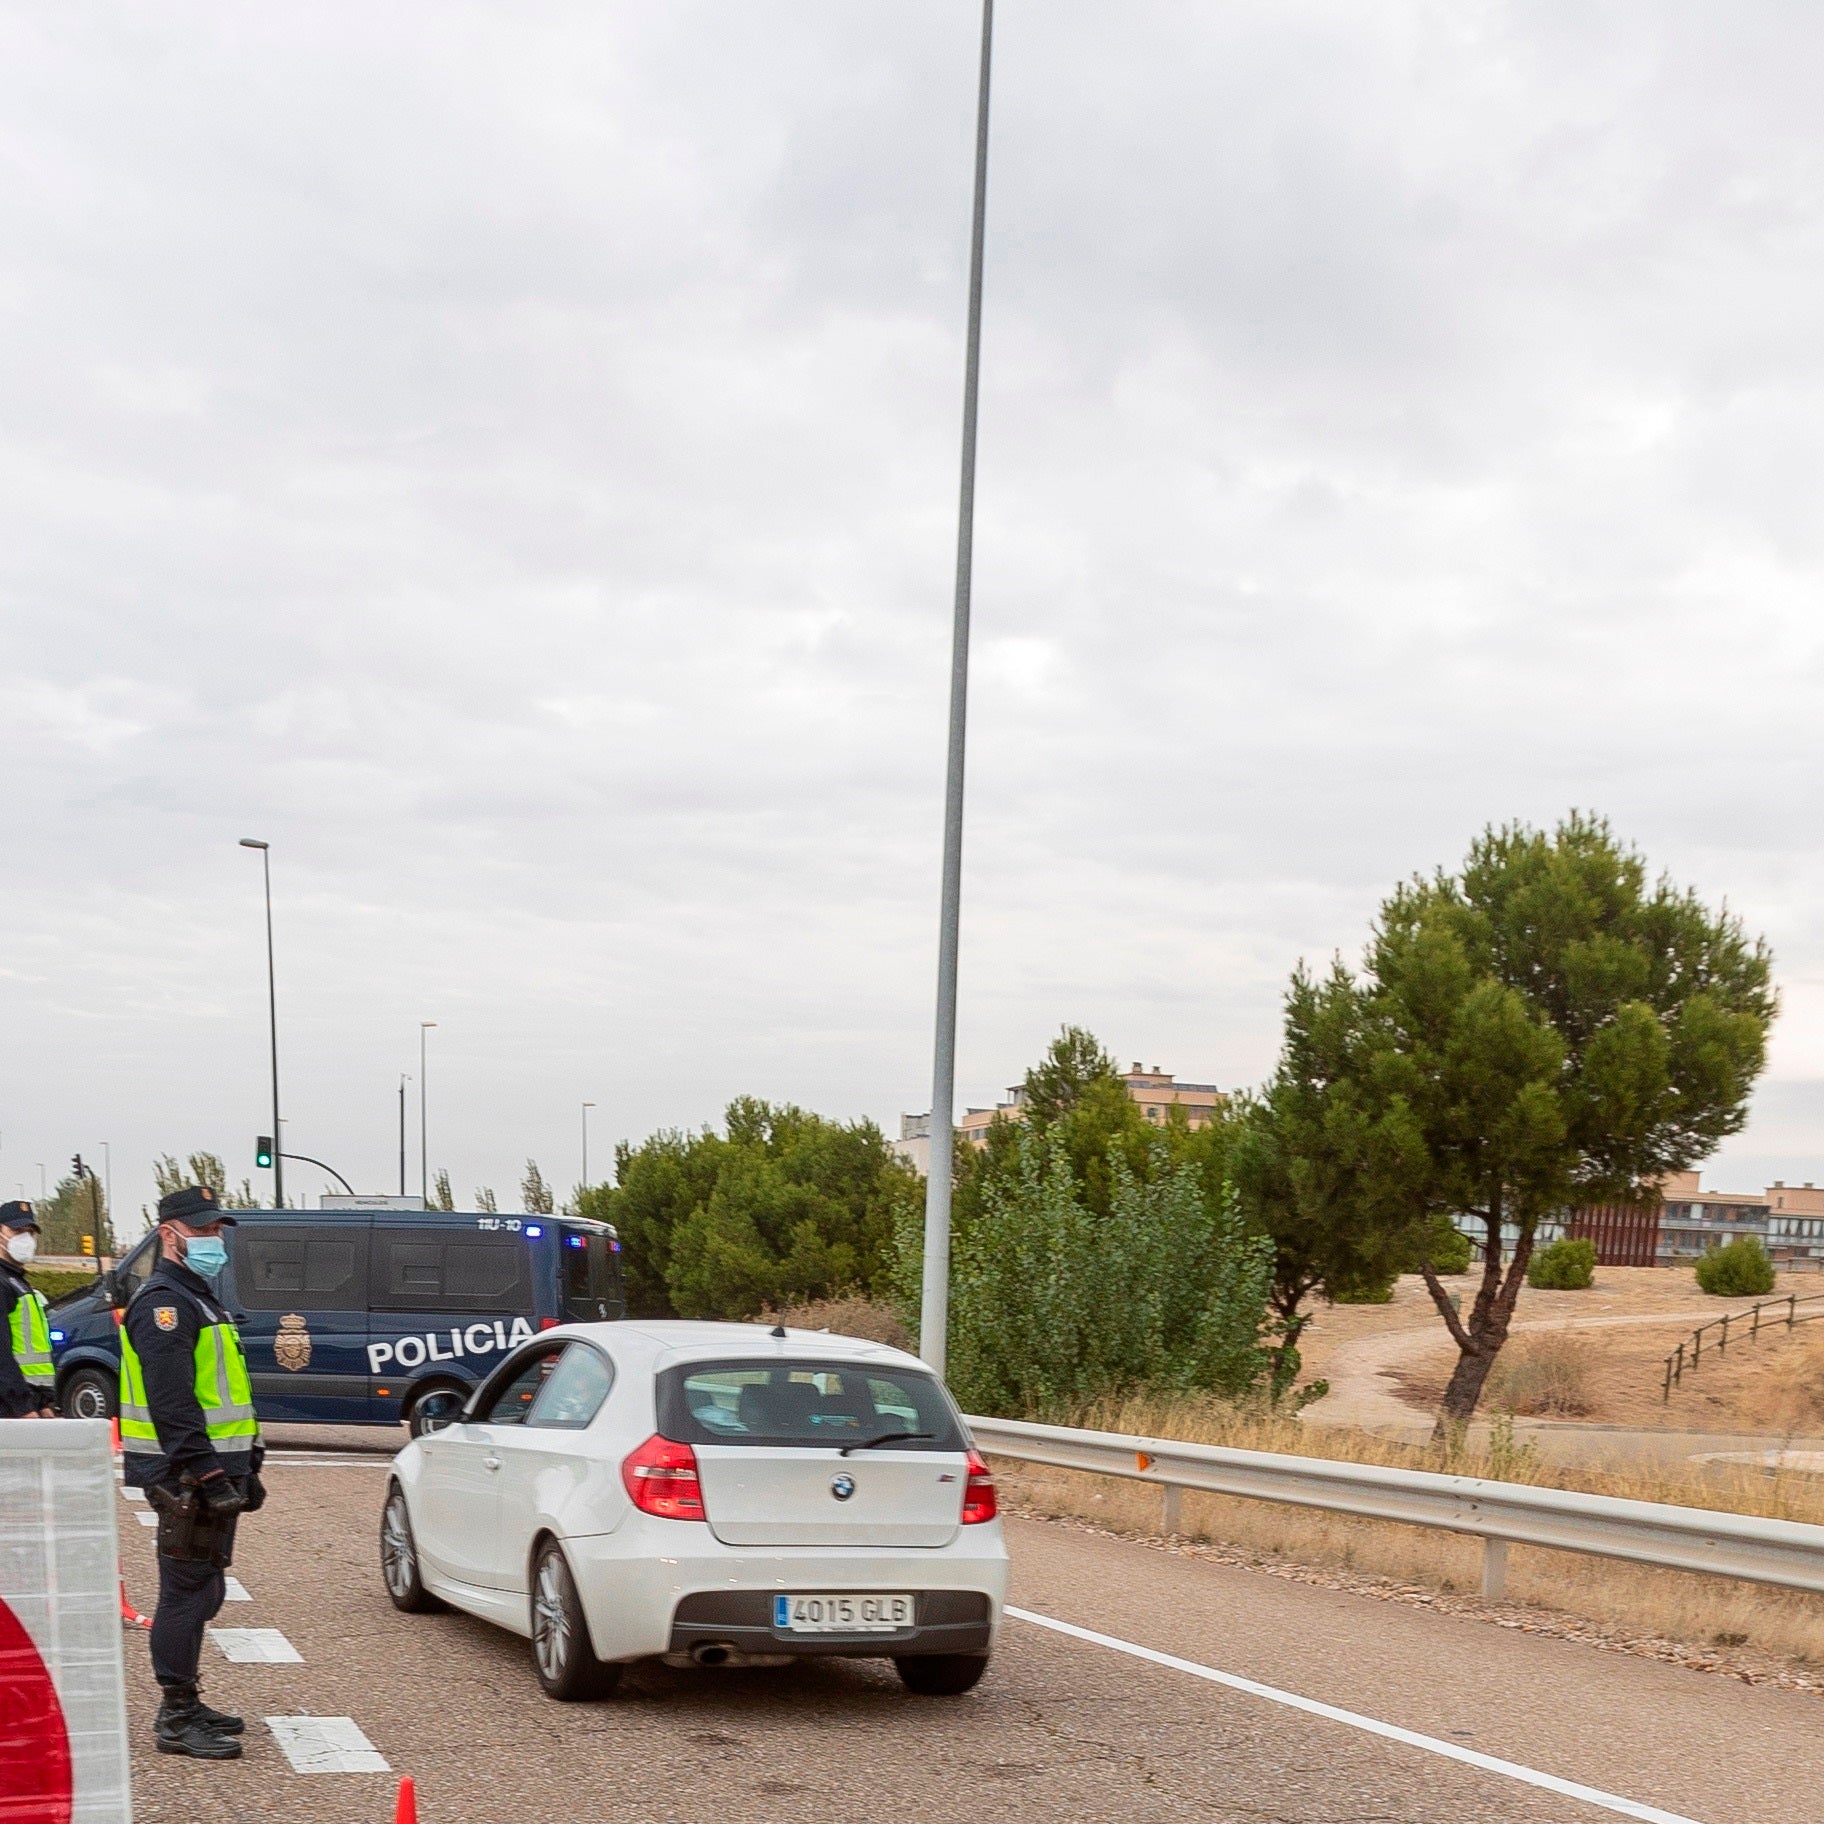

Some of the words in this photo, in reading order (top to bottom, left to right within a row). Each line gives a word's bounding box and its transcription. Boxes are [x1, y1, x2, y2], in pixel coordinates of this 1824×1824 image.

[367, 1317, 535, 1374] POLICIA
[793, 1600, 854, 1623] 4015
[860, 1600, 907, 1622] GLB
